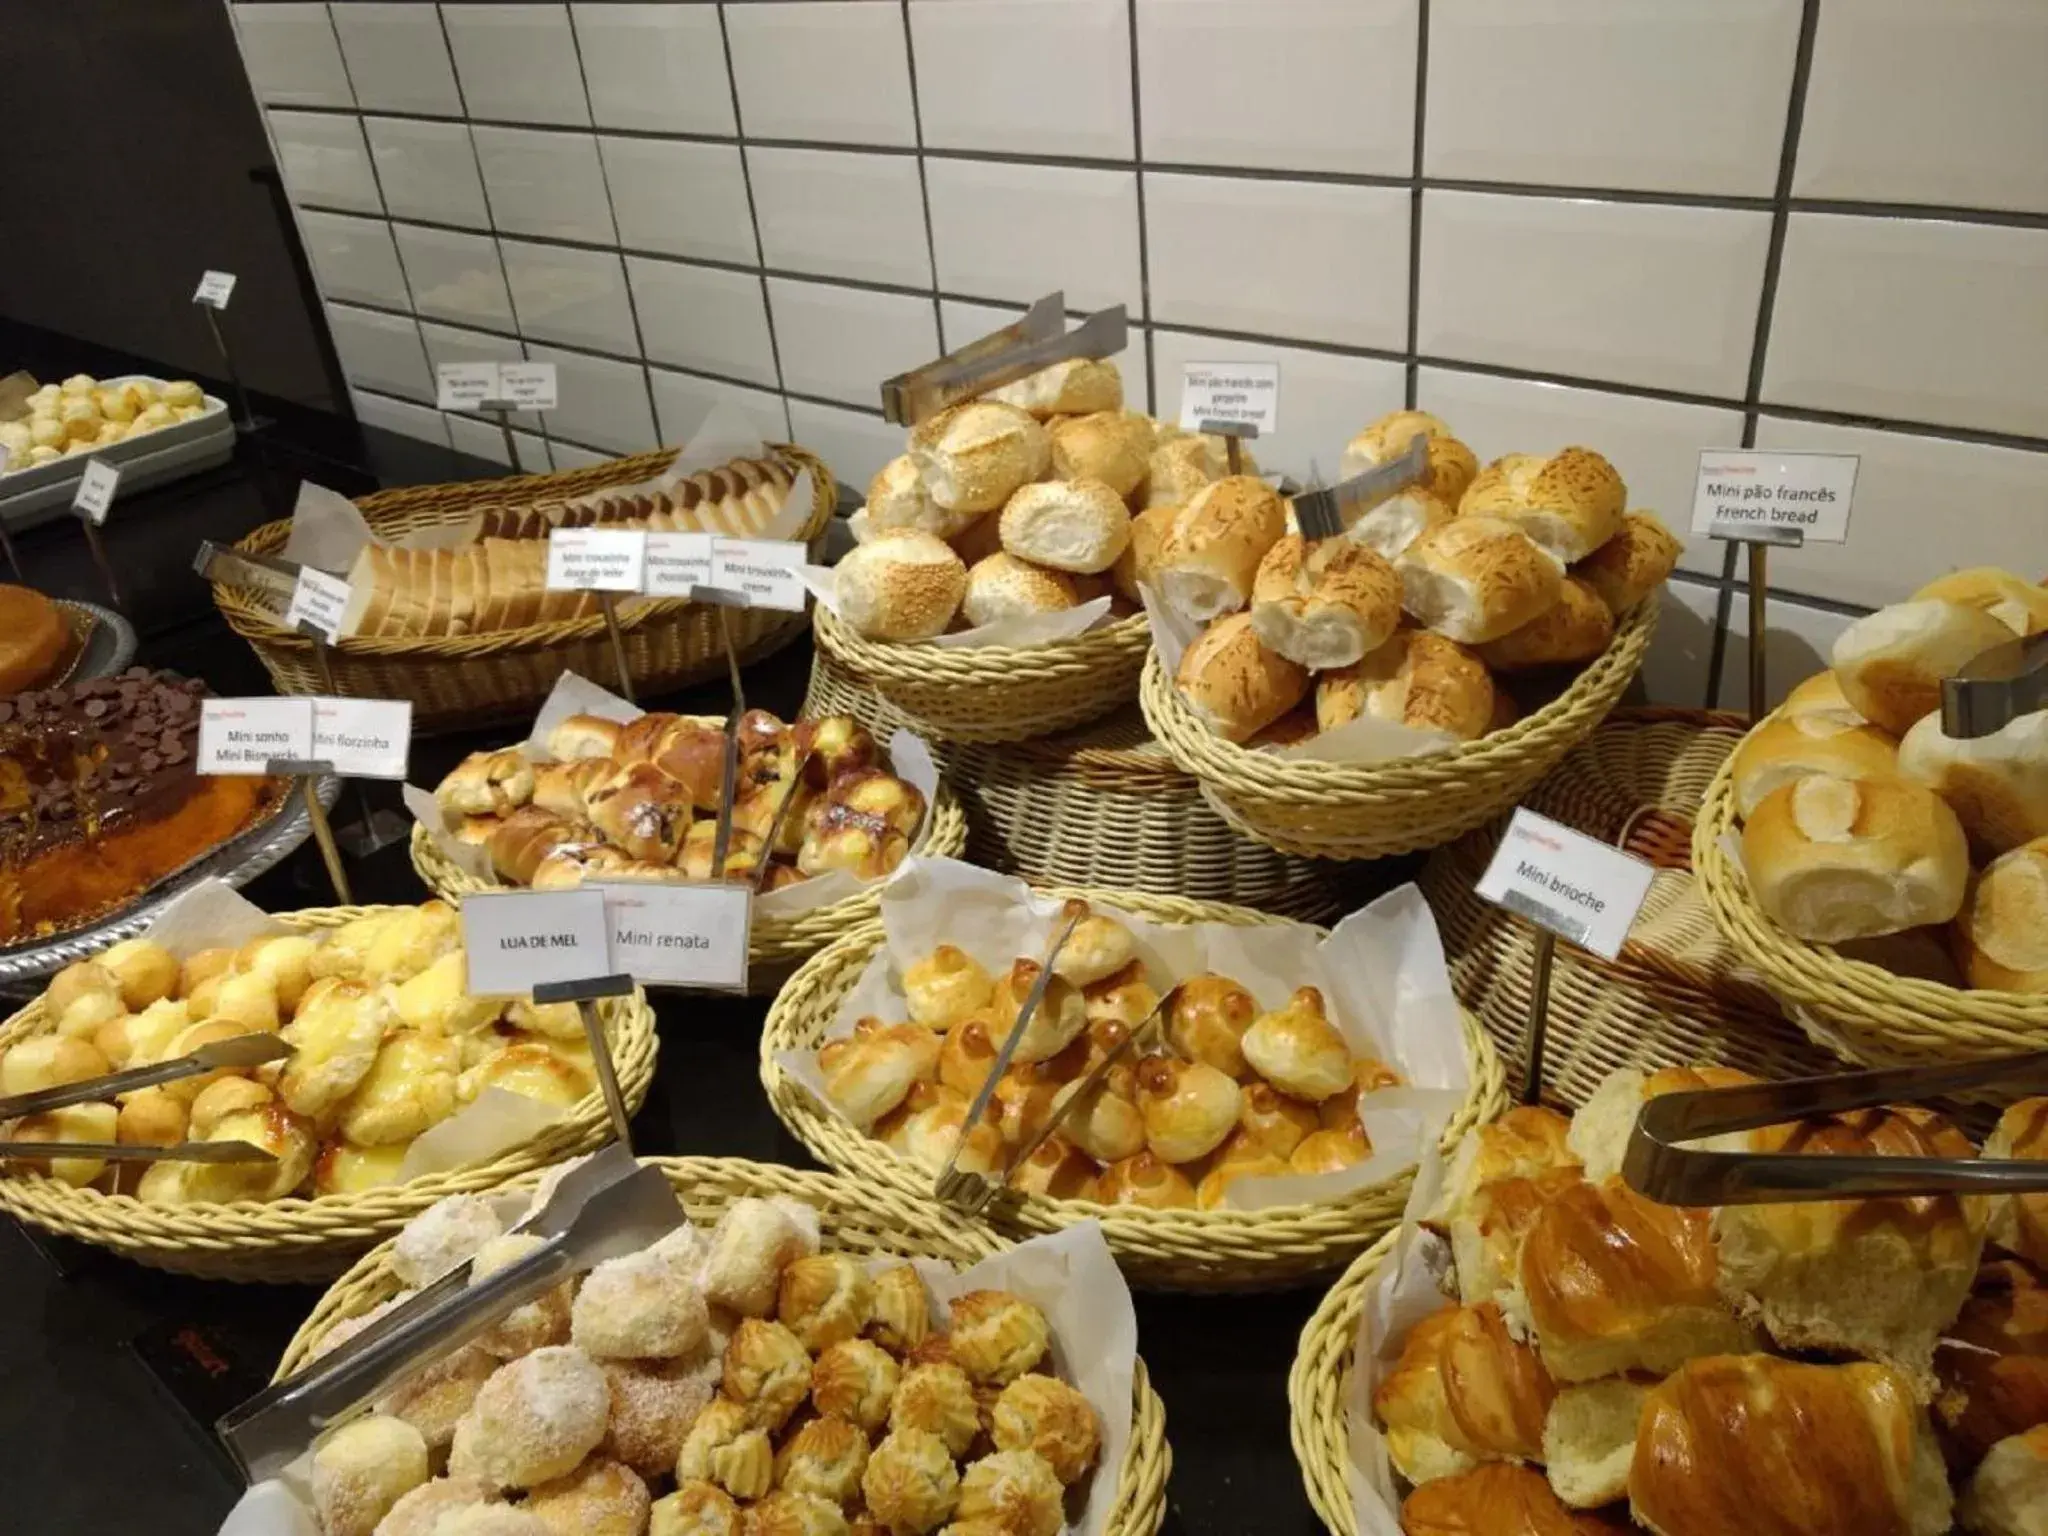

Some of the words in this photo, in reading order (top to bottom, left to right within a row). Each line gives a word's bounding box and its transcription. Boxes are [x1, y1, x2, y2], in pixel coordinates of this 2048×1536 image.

[1706, 483, 1740, 498] Mini
[1743, 484, 1773, 500] pão
[1776, 484, 1837, 503] francês
[1715, 505, 1767, 521] French
[1770, 507, 1819, 524] bread
[724, 561, 745, 574] Mini
[747, 563, 793, 578] trouxinha
[741, 581, 772, 593] creme
[227, 730, 253, 742] Mini
[255, 730, 290, 743] sonho
[337, 733, 389, 749] florzinha
[215, 748, 241, 762] Mini
[1516, 860, 1552, 887] Mini
[1549, 874, 1606, 913] brioche
[499, 935, 528, 950] LUA
[529, 934, 547, 949] DE
[550, 933, 579, 948] MEL
[615, 928, 653, 947] Mini
[656, 932, 710, 949] renata
